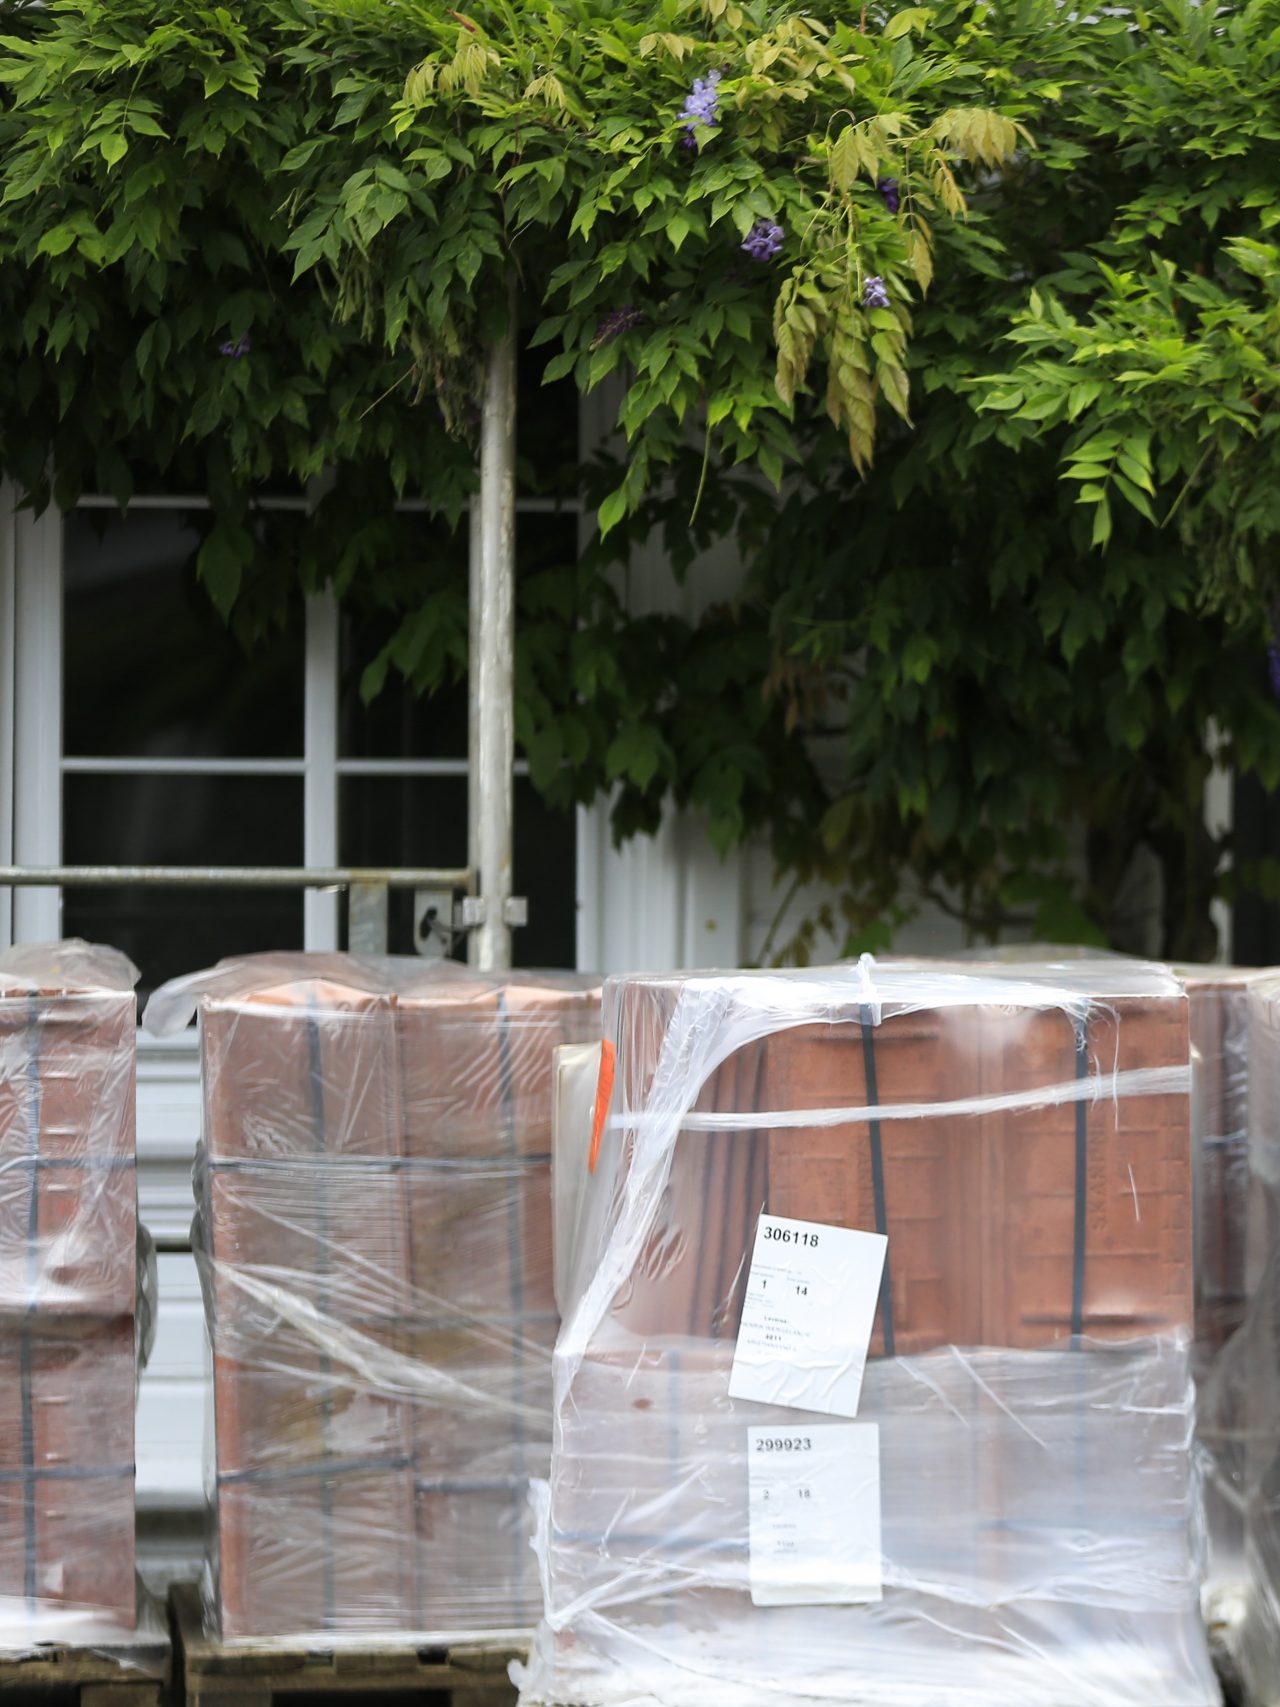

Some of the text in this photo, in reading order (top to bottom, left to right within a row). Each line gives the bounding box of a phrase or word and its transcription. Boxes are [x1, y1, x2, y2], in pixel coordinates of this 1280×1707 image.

[763, 1226, 819, 1248] 306118
[761, 1280, 767, 1290] 1
[796, 1285, 808, 1296] 14
[757, 1437, 812, 1452] 299923
